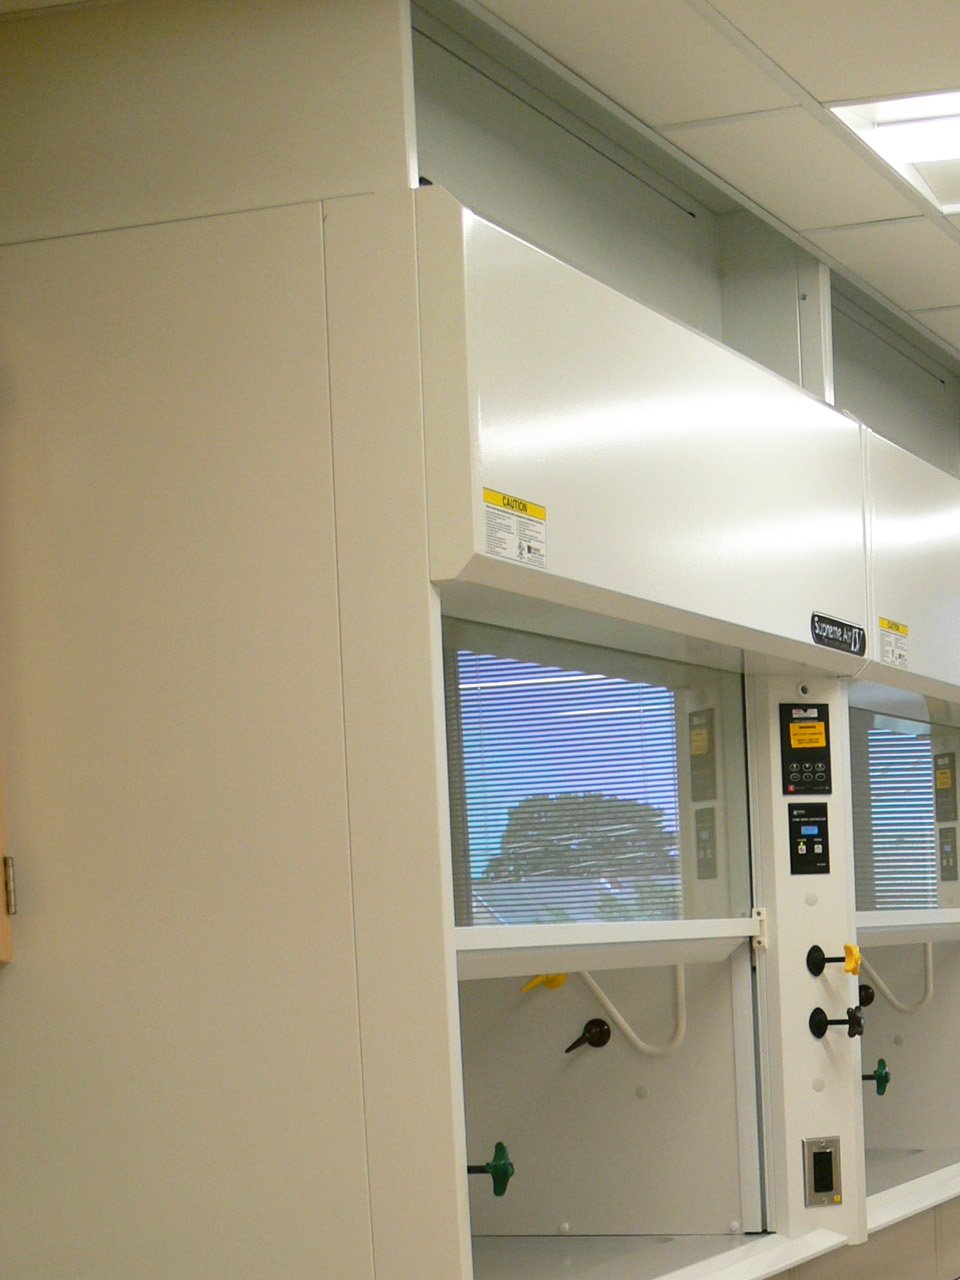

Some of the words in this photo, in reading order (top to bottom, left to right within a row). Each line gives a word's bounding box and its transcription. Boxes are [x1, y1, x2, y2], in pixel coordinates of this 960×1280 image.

[502, 496, 528, 513] CAUTION
[814, 616, 842, 641] Supreme
[850, 628, 863, 652] IV
